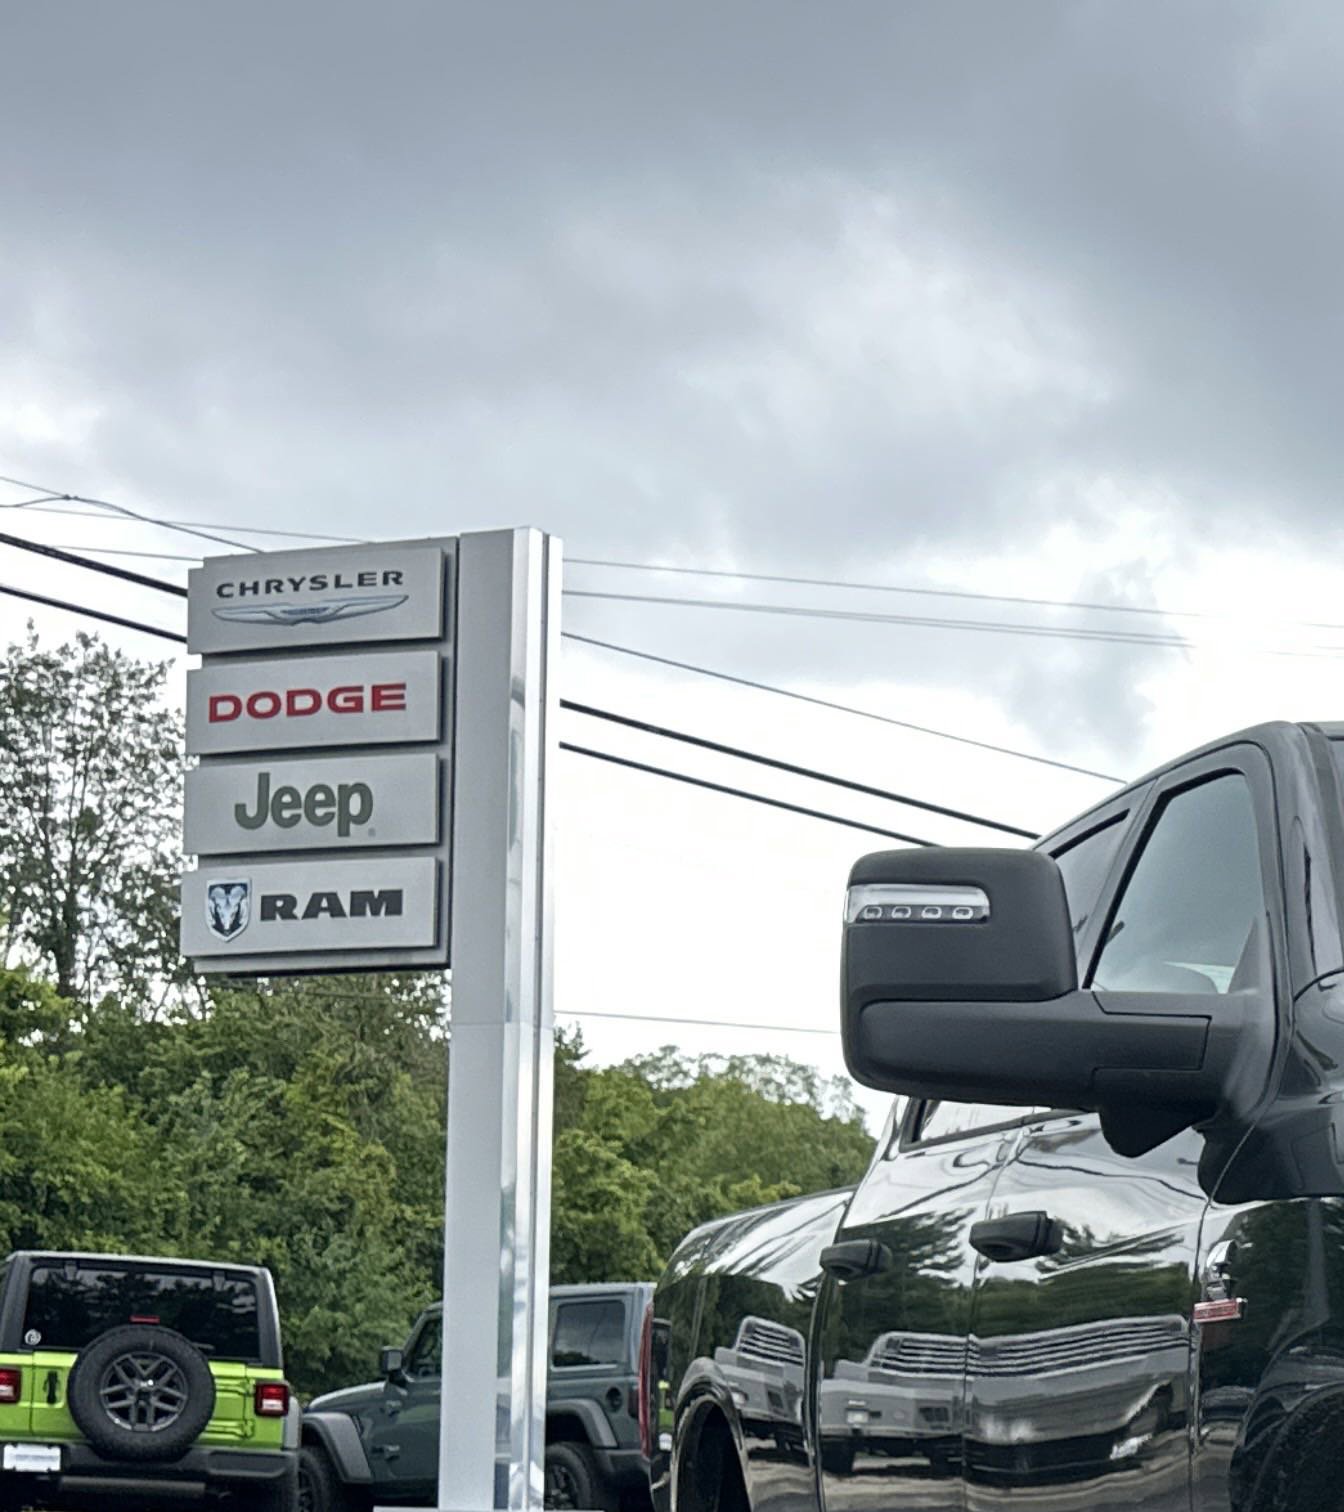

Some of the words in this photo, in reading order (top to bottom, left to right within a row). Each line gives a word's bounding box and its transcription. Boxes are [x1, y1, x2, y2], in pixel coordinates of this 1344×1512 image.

[216, 570, 404, 598] CHRYSLER
[208, 683, 407, 723] DODGE
[234, 772, 374, 837] Jeep
[260, 889, 403, 921] RAM
